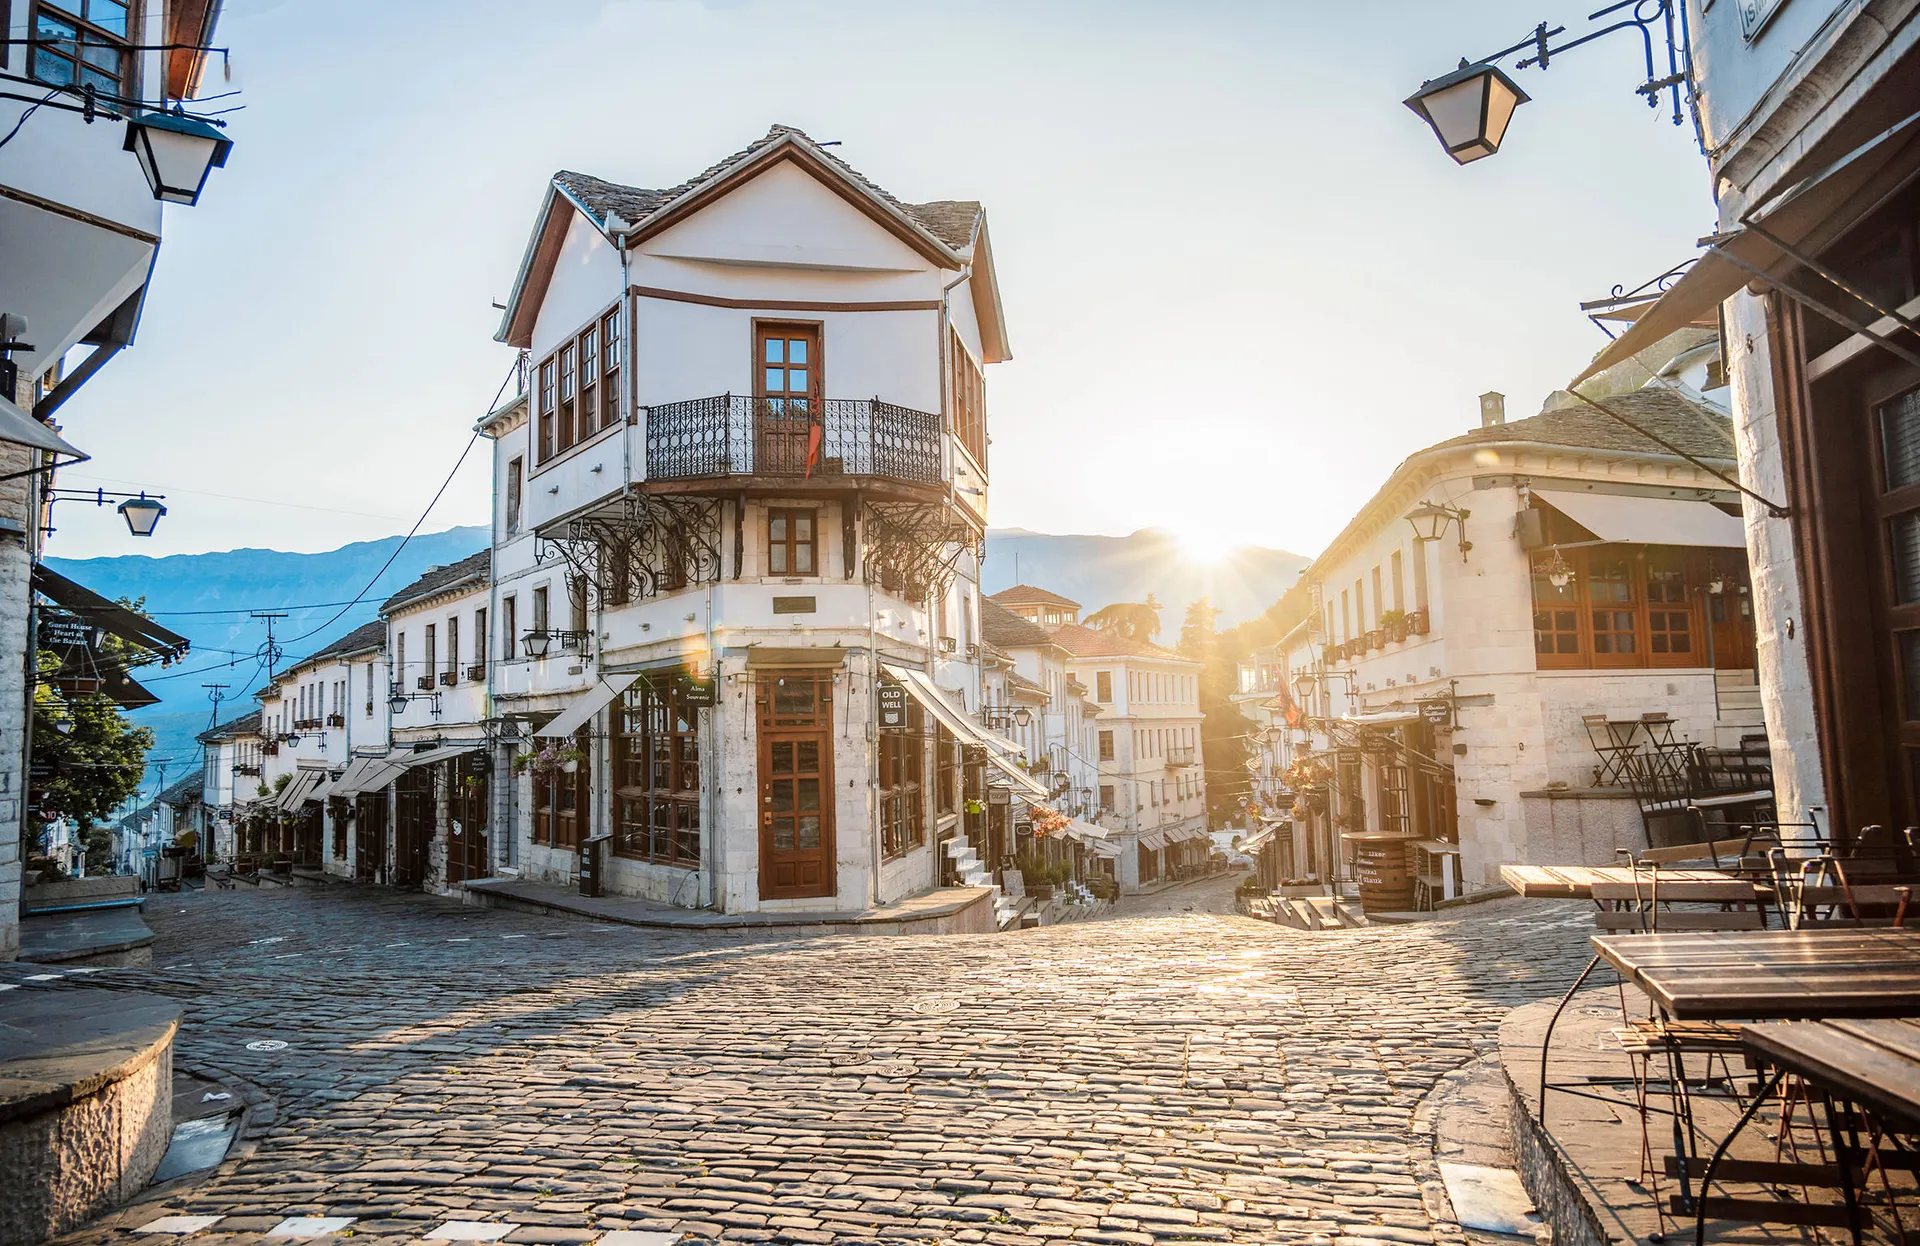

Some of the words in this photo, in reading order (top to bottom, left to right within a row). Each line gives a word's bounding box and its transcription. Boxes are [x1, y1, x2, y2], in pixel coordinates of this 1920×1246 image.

[48, 621, 69, 629] Guest
[70, 623, 93, 631] House
[882, 691, 900, 699] OLD
[881, 701, 902, 709] WELL
[47, 811, 57, 819] 10
